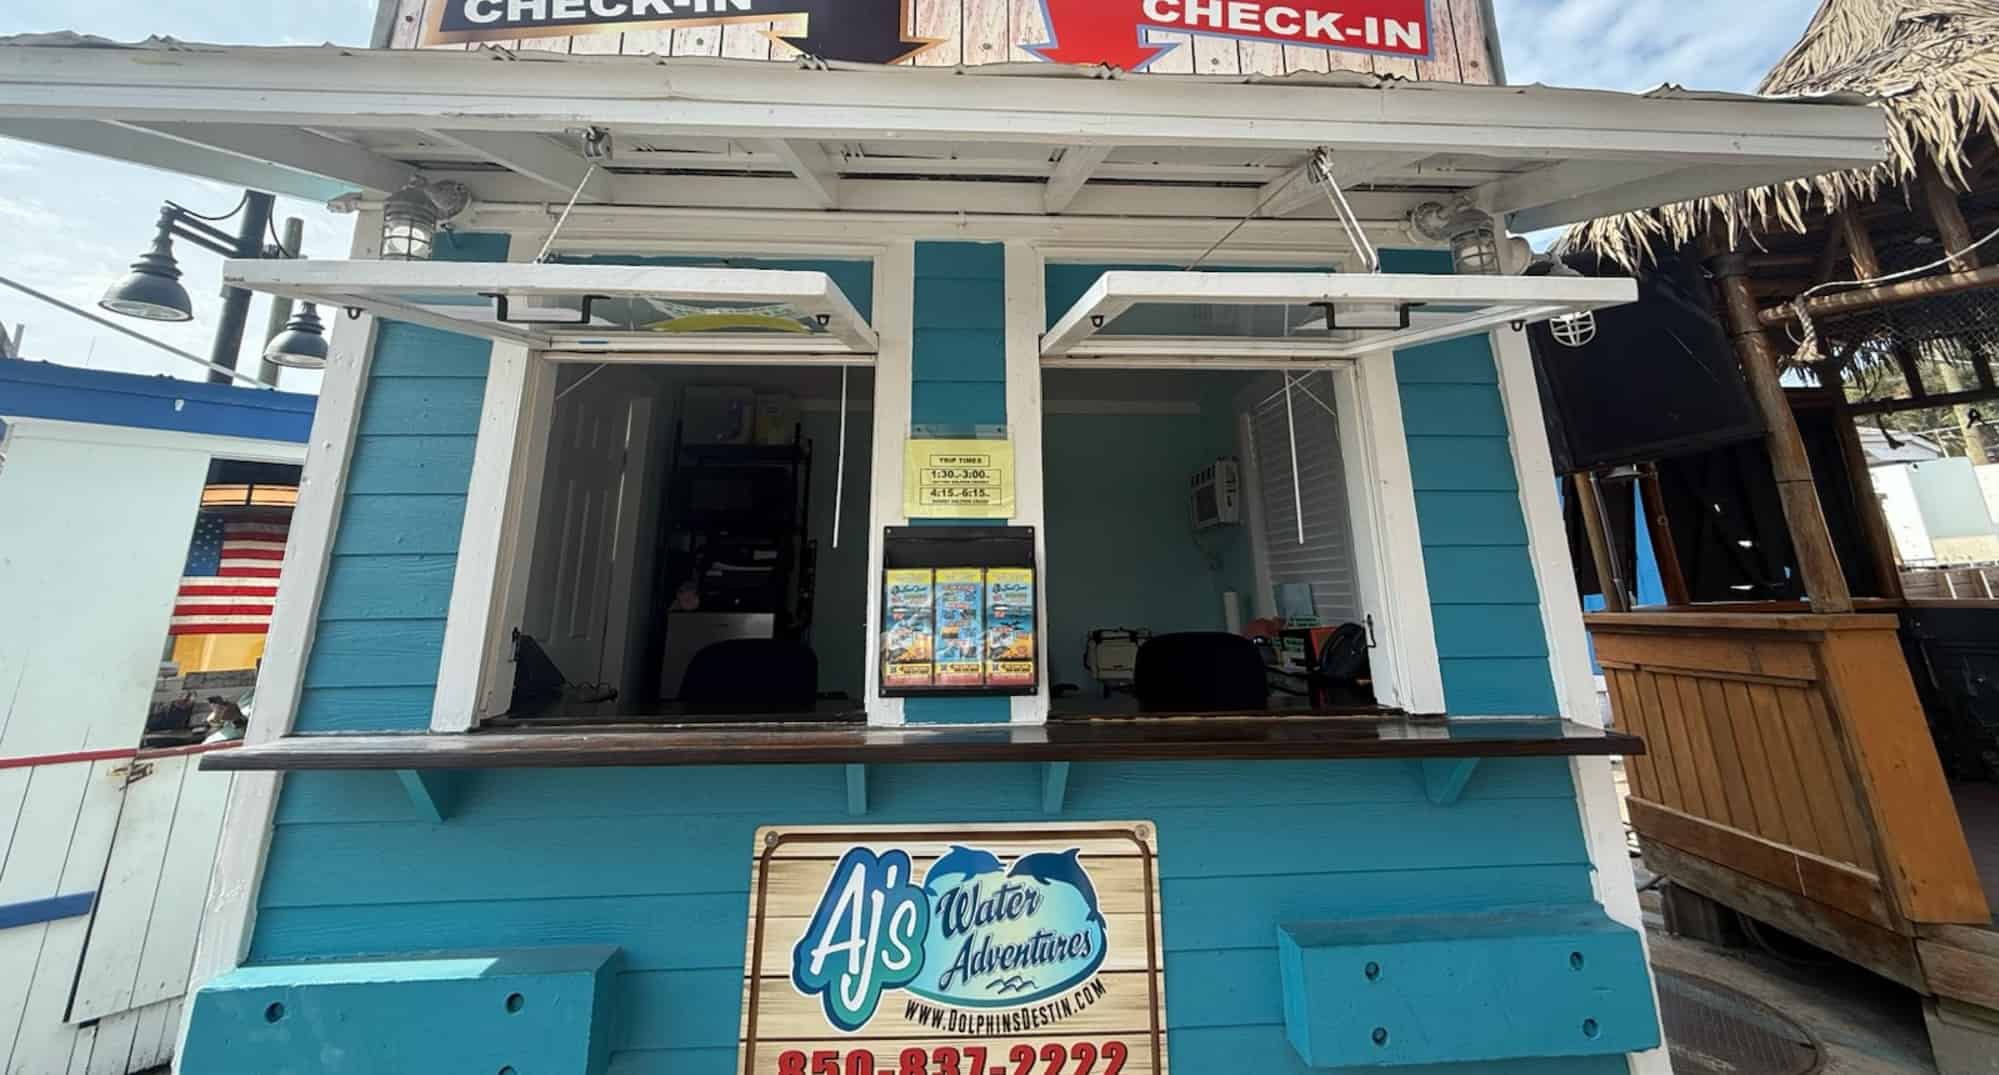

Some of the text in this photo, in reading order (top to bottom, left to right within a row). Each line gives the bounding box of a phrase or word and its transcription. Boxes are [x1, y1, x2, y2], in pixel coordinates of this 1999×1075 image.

[1142, 0, 1422, 50] CHECK-IN
[939, 457, 983, 465] TRIP TIMES
[935, 879, 1042, 939] Water
[938, 928, 1093, 992] Adventures
[778, 1041, 1129, 1075] 850-837-2222
